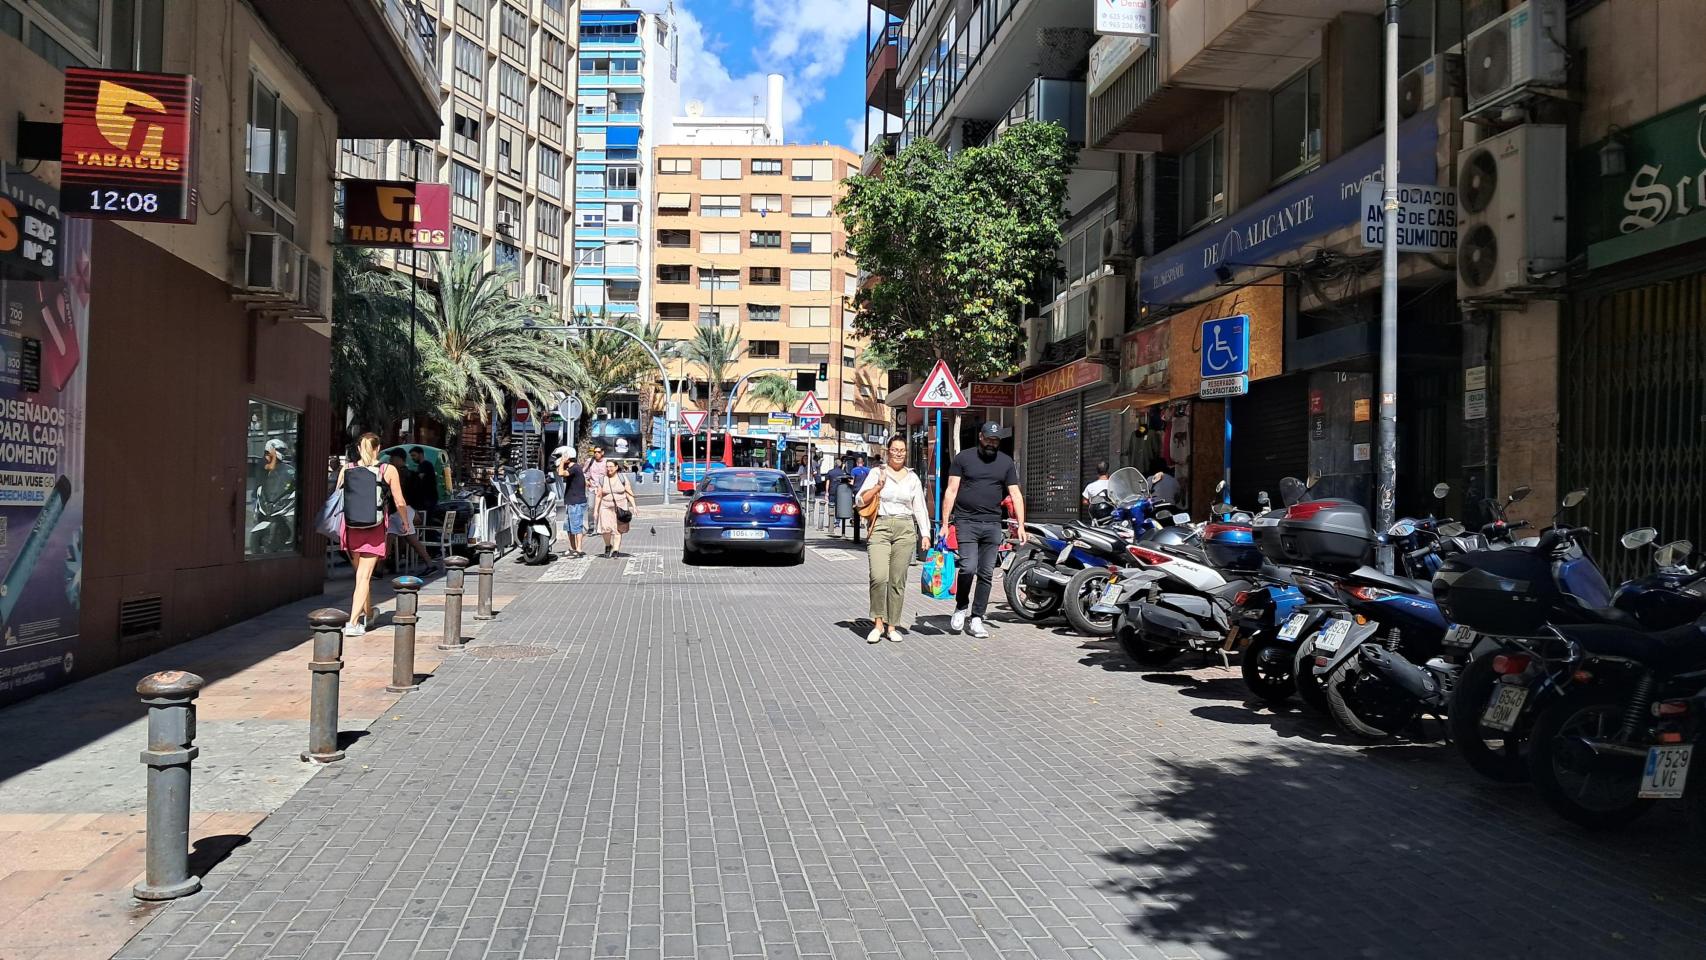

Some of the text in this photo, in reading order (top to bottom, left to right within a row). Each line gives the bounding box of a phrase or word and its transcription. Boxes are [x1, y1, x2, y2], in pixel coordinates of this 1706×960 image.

[1121, 0, 1147, 9] Dental
[75, 151, 180, 171] TABACOS
[90, 189, 158, 213] 12:08
[1367, 204, 1457, 228] AMS DE CAS
[350, 225, 445, 245] TABACOS
[1203, 195, 1314, 269] DE ALICANTE
[973, 384, 1014, 395] BAZAR
[1035, 365, 1075, 399] BAZAR
[1202, 385, 1242, 396] DISCAPACITADOS
[1207, 378, 1235, 388] RESERVADO
[0, 397, 65, 427] DISEÑADOS
[33, 425, 65, 447] CADA
[0, 474, 23, 487] AMILIA
[25, 475, 43, 488] VUSE
[1657, 750, 1689, 768] 7529
[1652, 769, 1677, 788] LVG
